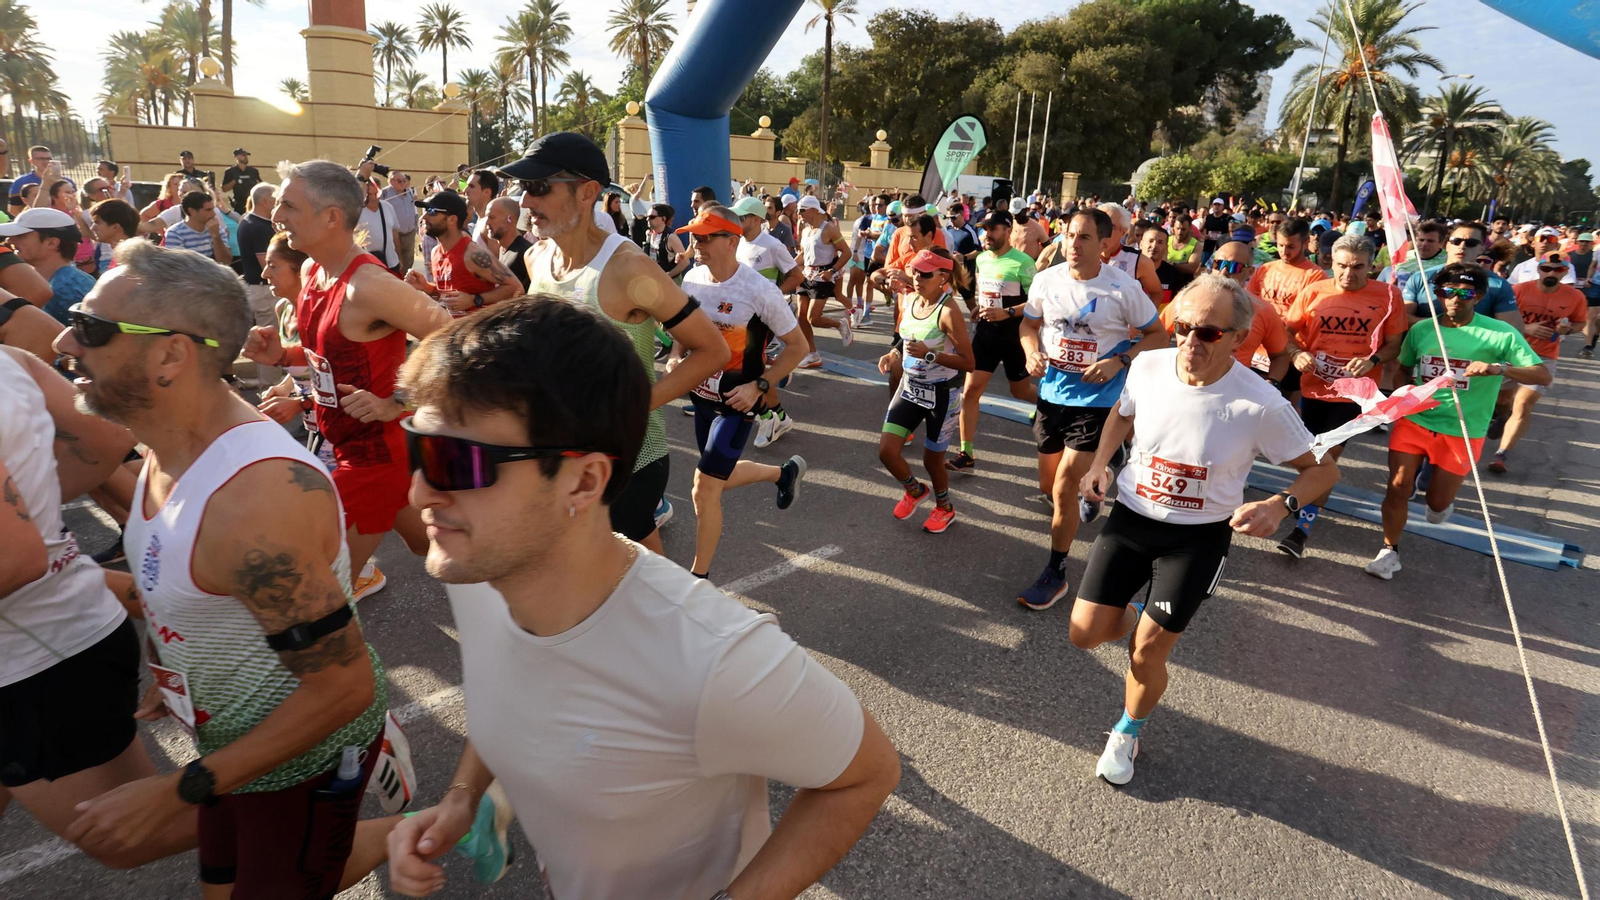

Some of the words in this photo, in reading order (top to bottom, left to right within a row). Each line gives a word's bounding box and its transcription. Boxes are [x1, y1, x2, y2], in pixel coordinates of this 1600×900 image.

[1059, 349, 1085, 363] 283
[1322, 364, 1345, 377] 374
[1151, 472, 1188, 494] 549
